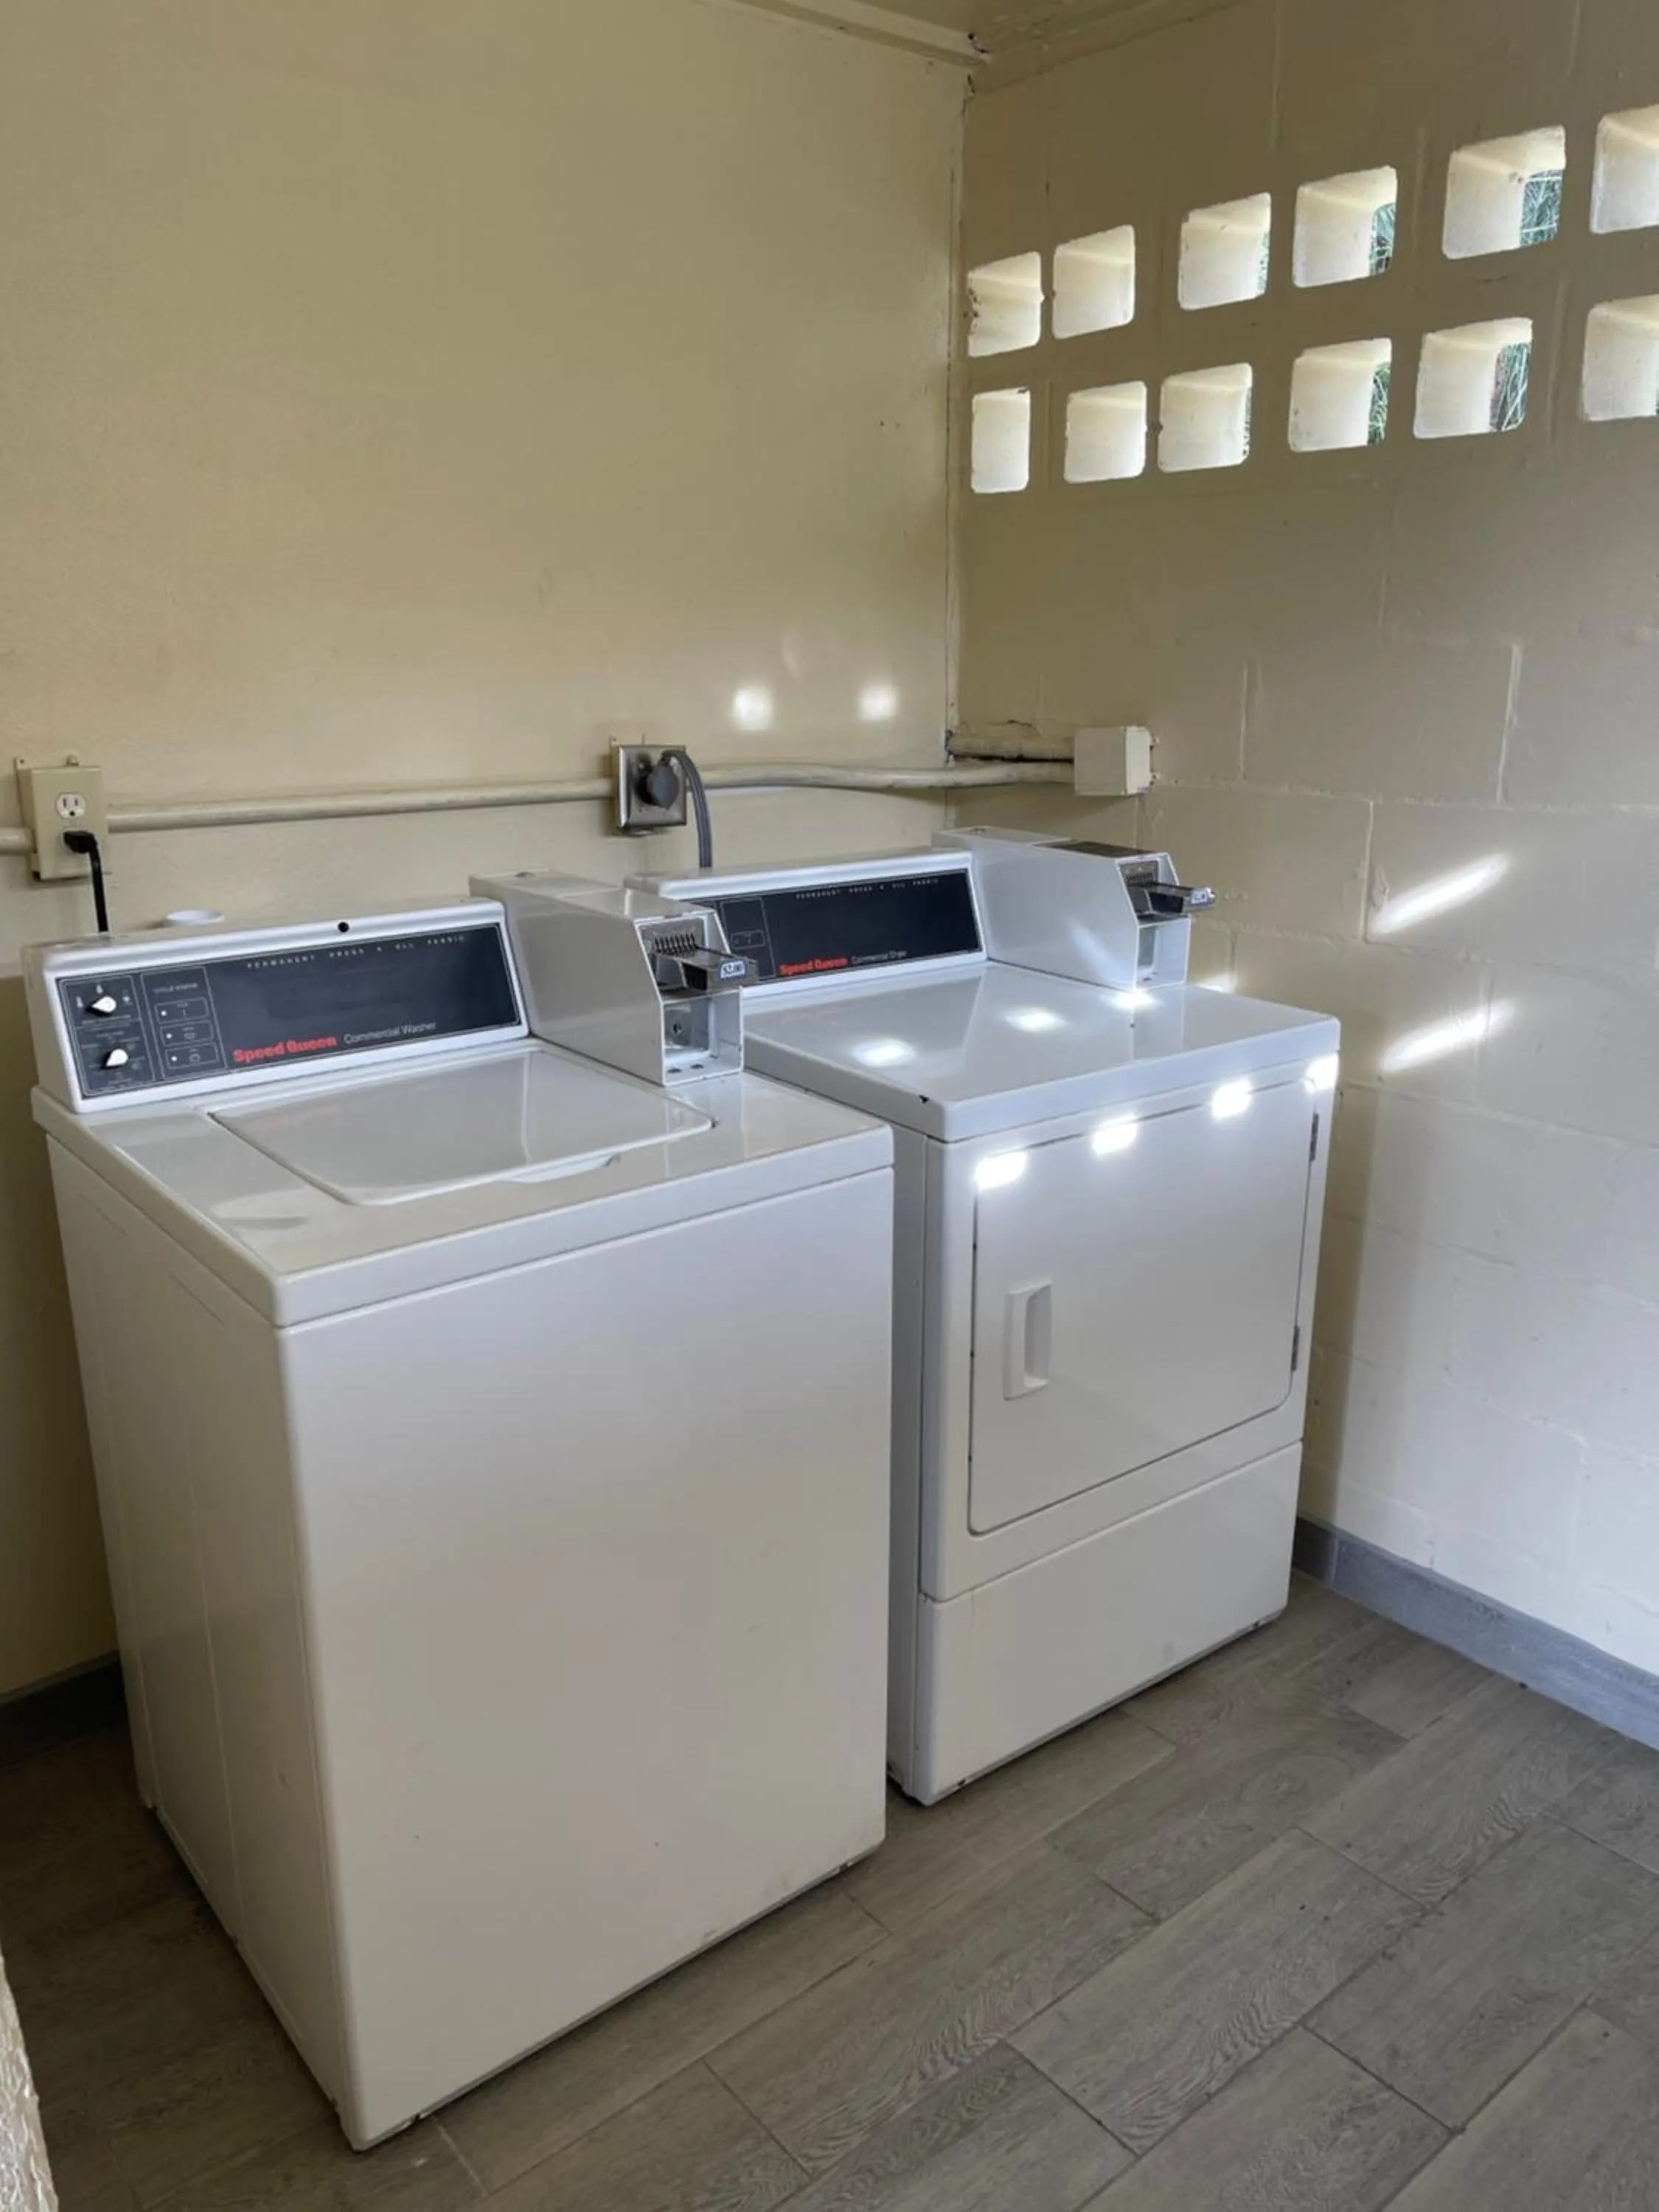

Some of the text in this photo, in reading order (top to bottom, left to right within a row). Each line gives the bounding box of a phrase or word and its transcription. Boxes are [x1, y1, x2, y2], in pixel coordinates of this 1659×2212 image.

[232, 1021, 437, 1064] Speed Queen Commercial Washer
